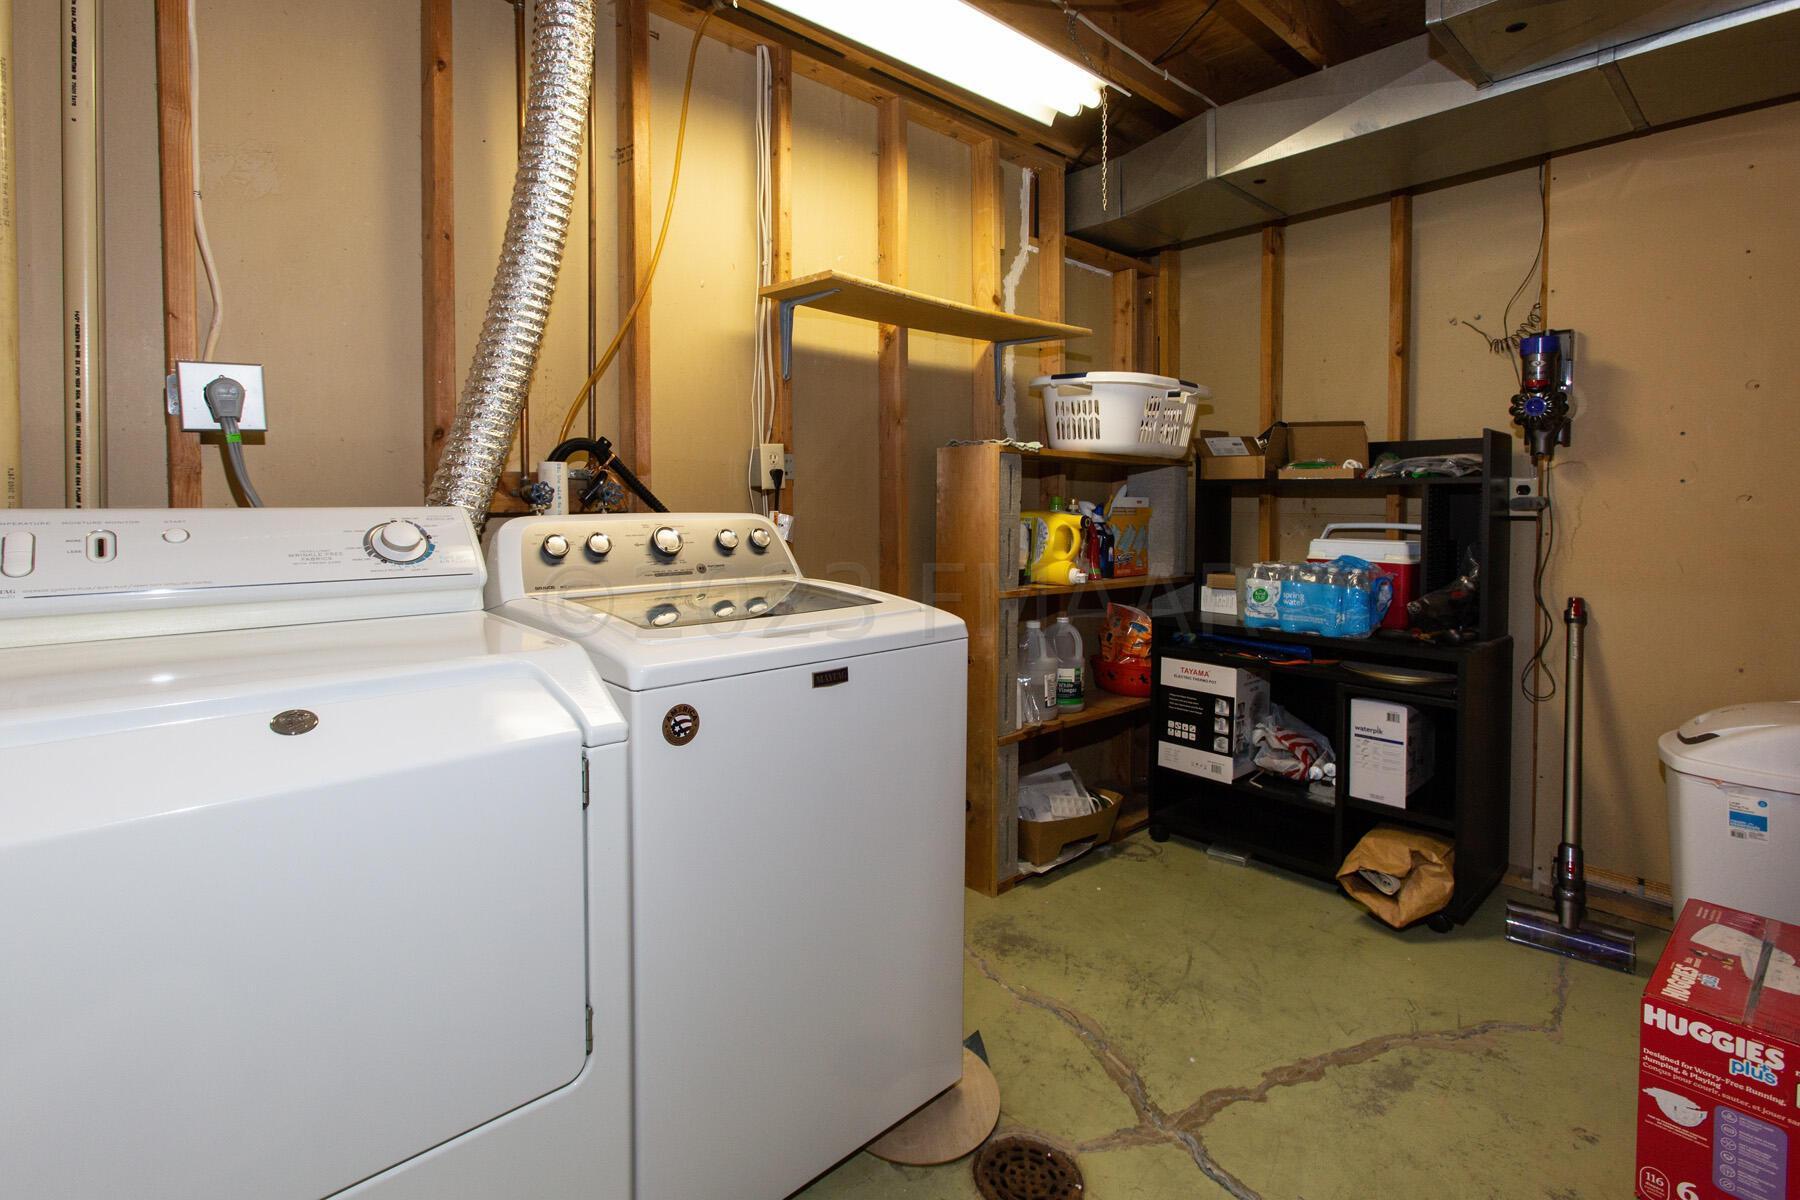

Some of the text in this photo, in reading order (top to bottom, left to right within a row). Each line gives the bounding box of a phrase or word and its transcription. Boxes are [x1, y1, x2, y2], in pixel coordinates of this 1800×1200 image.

[1181, 666, 1210, 678] TAYAMA
[1354, 724, 1384, 735] waterpik
[1643, 1003, 1785, 1071] HUGGIES
[1643, 1047, 1680, 1066] Designed
[1681, 1061, 1694, 1070] for
[1689, 1072, 1722, 1089] Playing
[1731, 1059, 1778, 1086] plus
[1672, 1074, 1693, 1085] pour
[1761, 1107, 1787, 1121] jouer
[1645, 1171, 1665, 1187] 116
